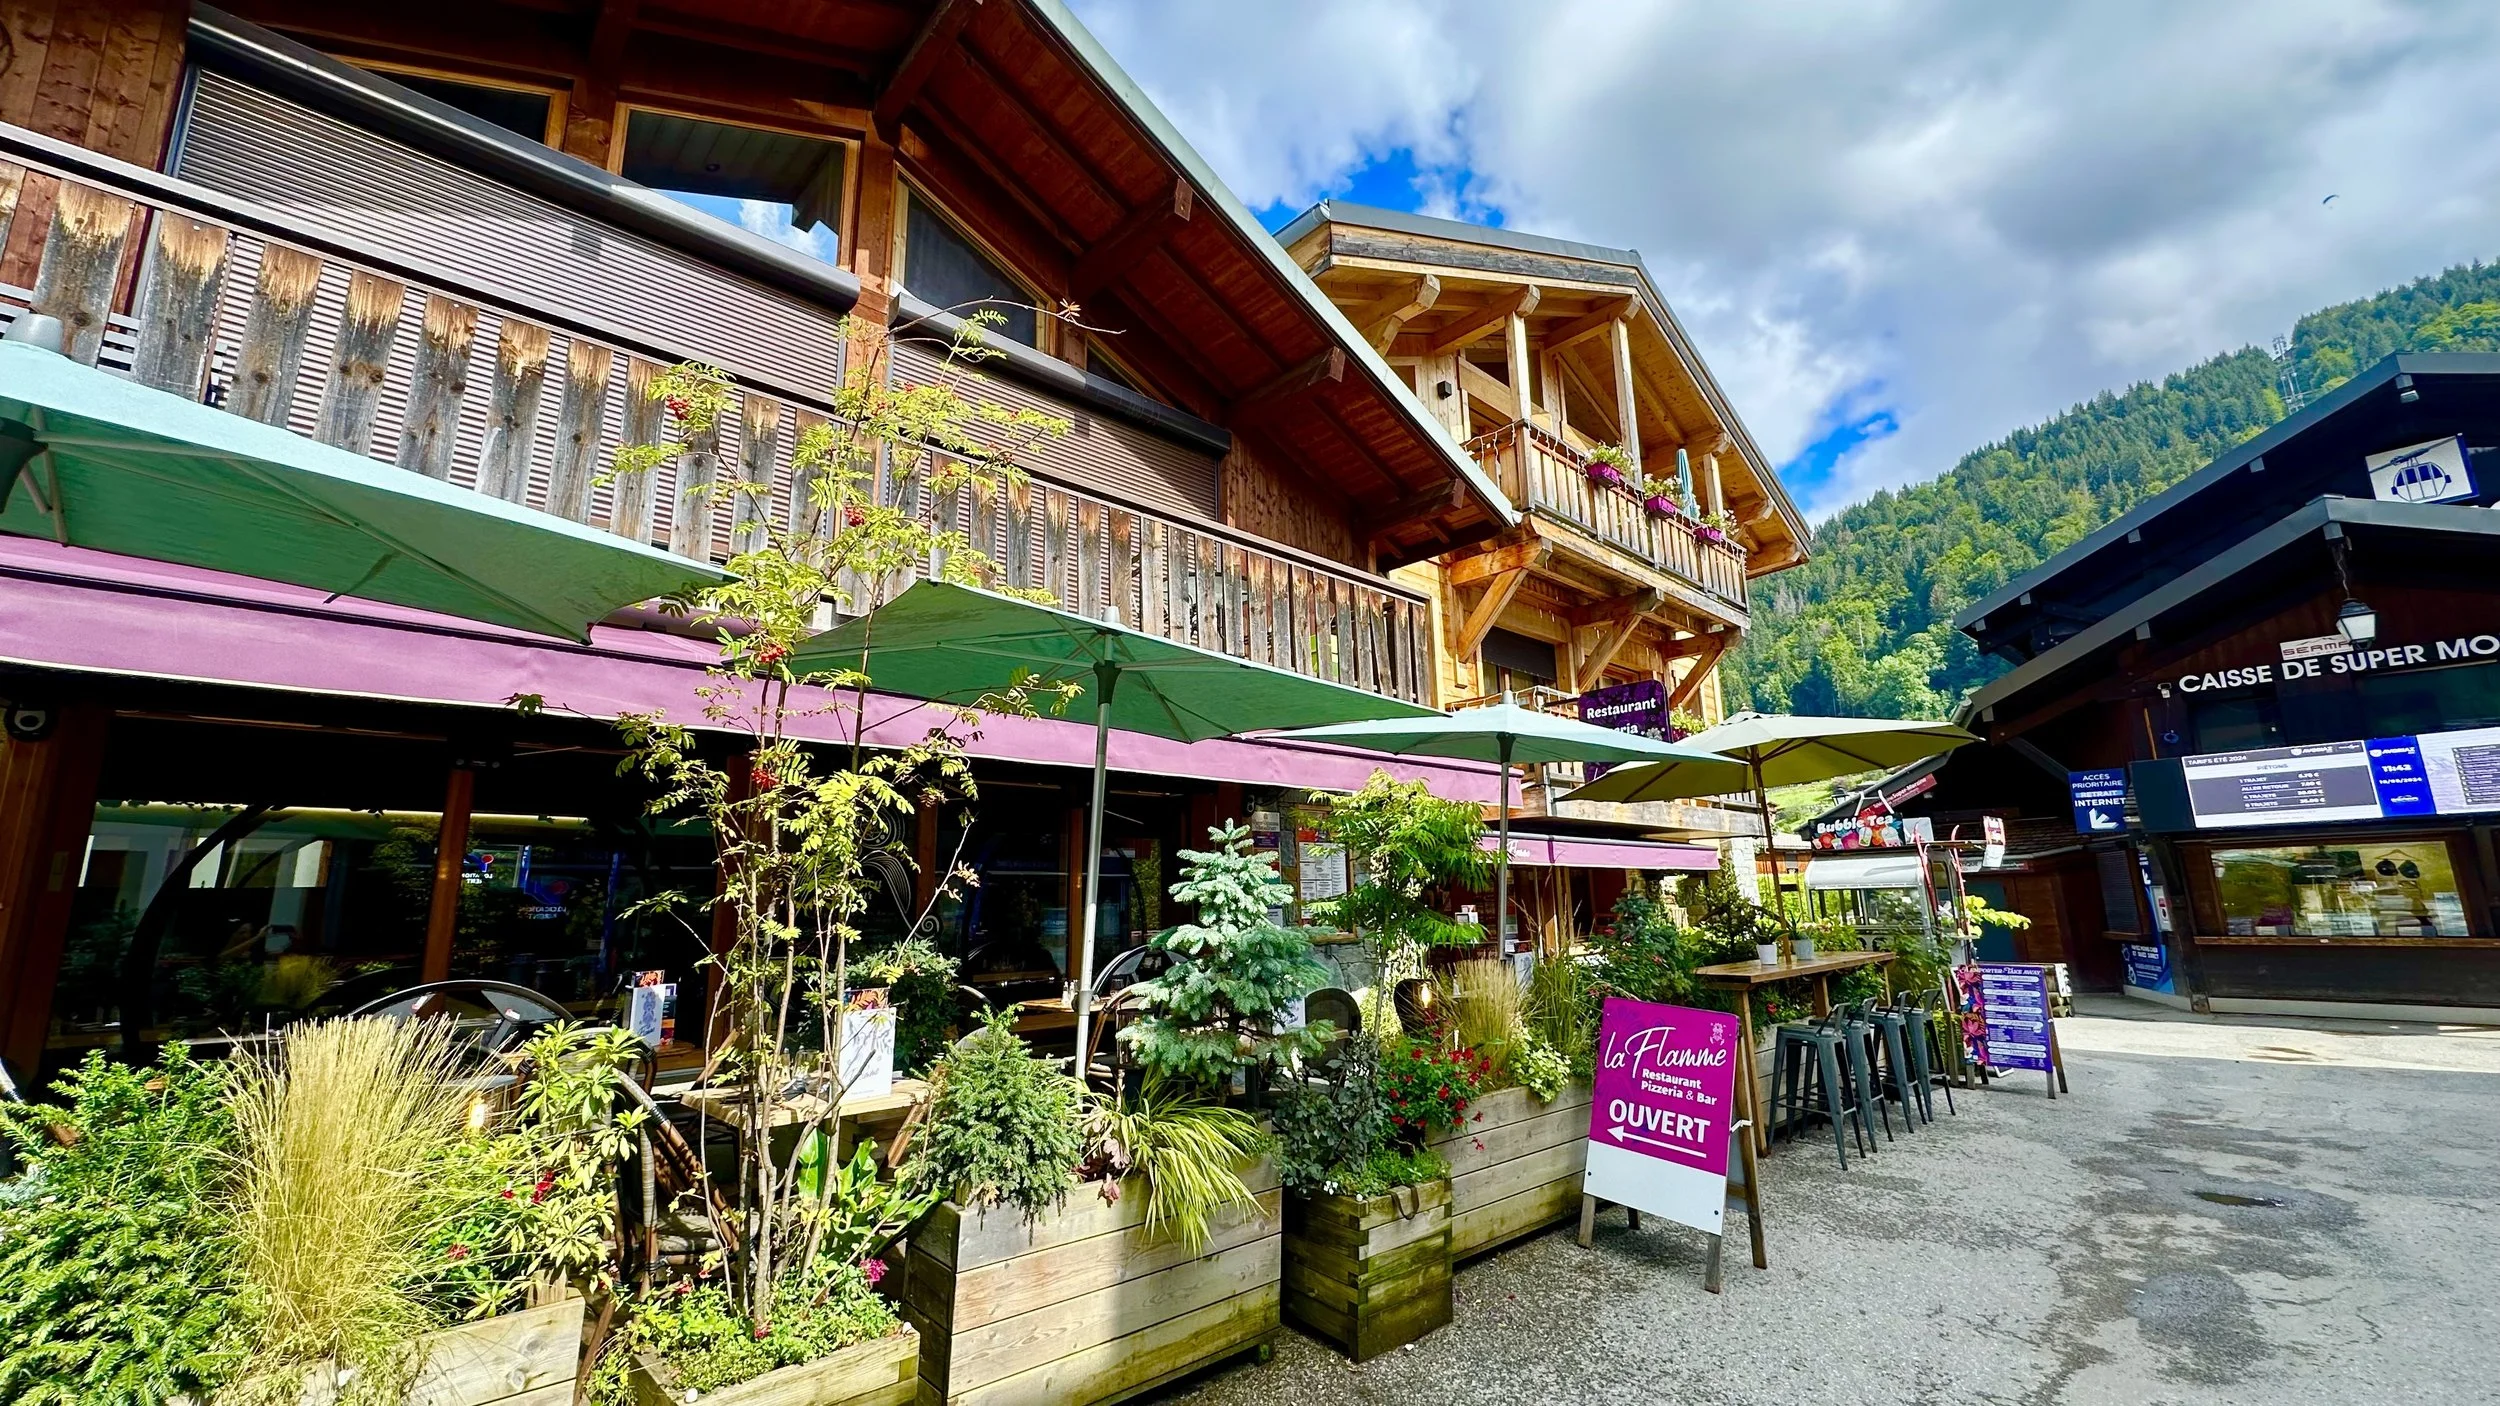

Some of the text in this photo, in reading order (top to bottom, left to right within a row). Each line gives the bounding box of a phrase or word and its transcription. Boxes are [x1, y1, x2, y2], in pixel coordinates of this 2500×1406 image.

[2178, 665, 2273, 693] CAISSE
[2282, 658, 2322, 680] DE
[2331, 644, 2427, 674] SUPER
[2435, 634, 2500, 660] MO
[1587, 697, 1656, 719] Restaurant
[2187, 758, 2213, 766] TARIFS
[2072, 780, 2123, 789] PRIORITAIRE
[2080, 790, 2118, 798] RETRAIT
[2074, 797, 2126, 807] INTERNET
[1817, 814, 1894, 834] Bubble Tea
[1604, 1027, 1727, 1079] la Flamme
[1642, 1069, 1702, 1089] Restaurant
[1641, 1080, 1718, 1105] Pizzeria & Bar
[1609, 1099, 1711, 1143] OUVERT
